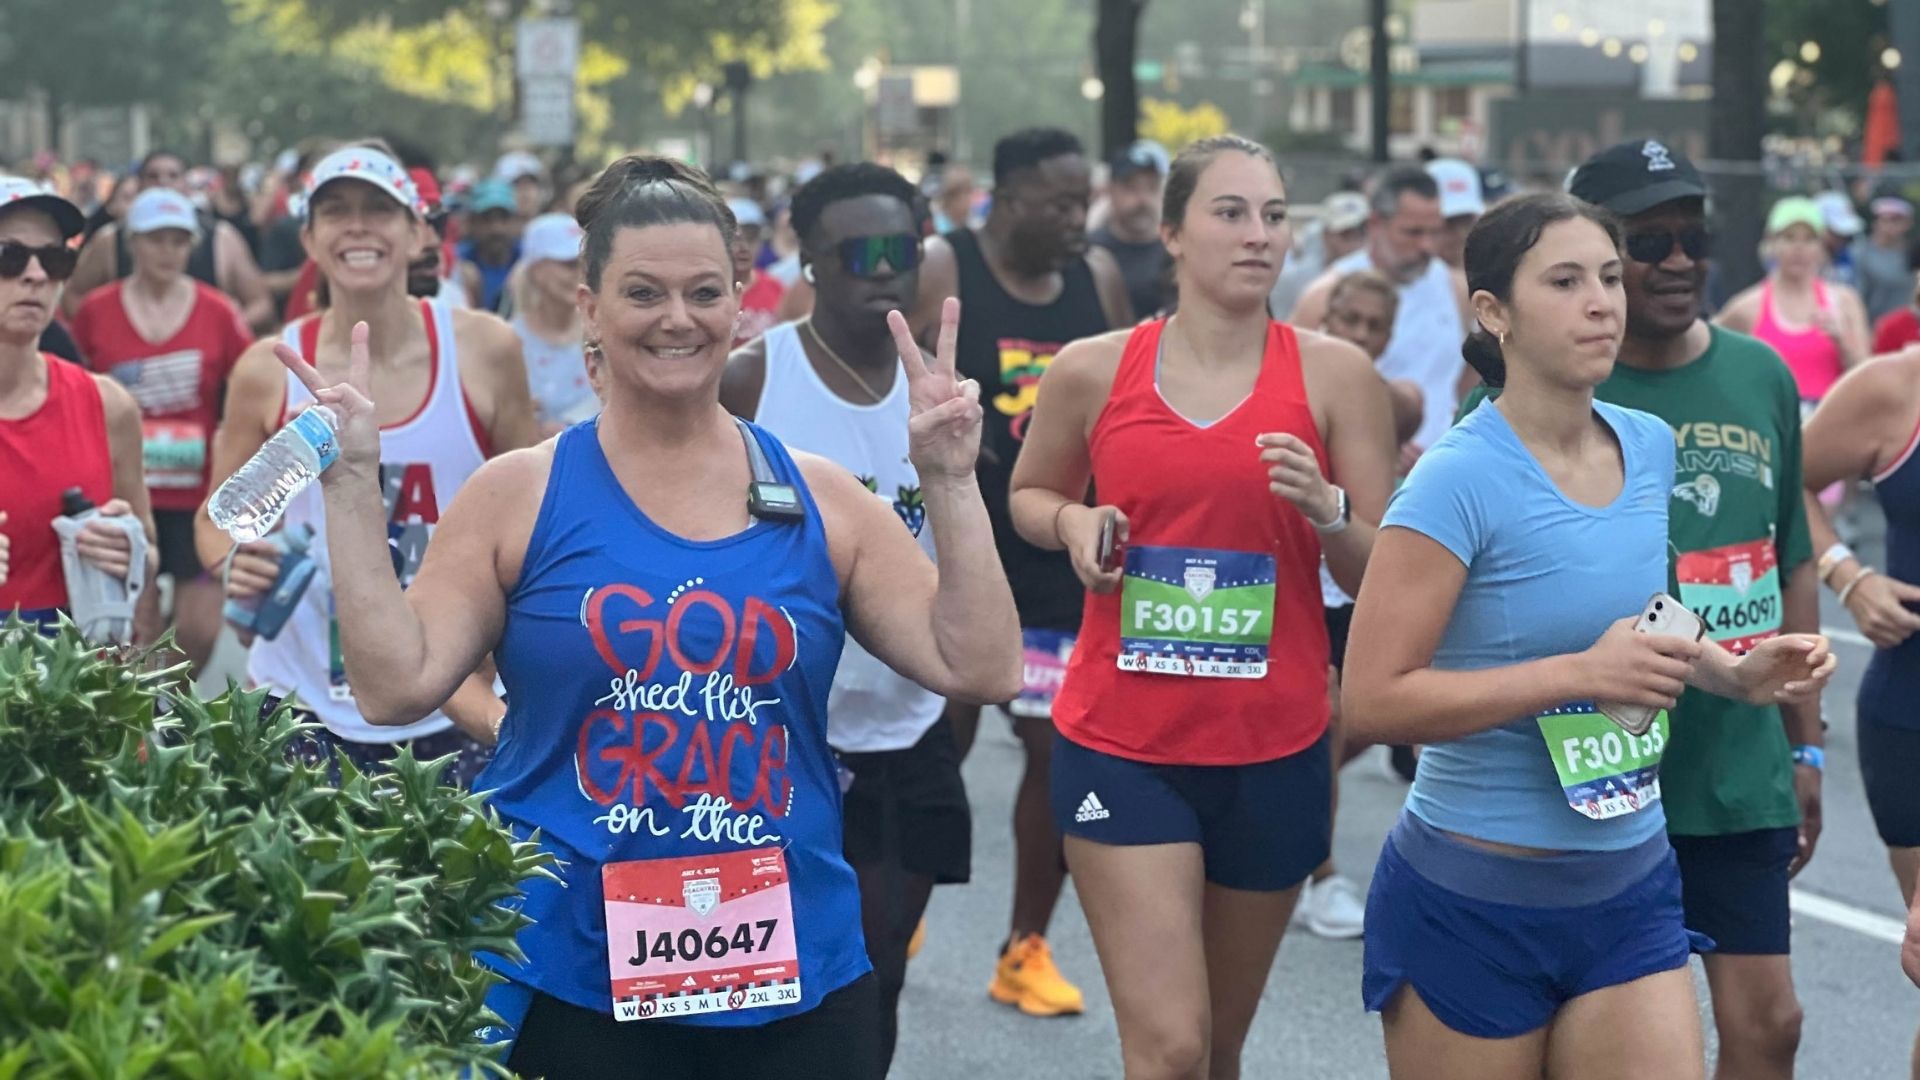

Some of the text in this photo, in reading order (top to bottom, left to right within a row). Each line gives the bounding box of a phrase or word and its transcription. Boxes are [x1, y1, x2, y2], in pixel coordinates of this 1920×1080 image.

[1675, 450, 1760, 480] MS
[1134, 600, 1262, 636] F30157
[1693, 594, 1776, 633] K46097
[587, 583, 795, 686] GOD
[1123, 658, 1134, 667] W
[1154, 660, 1166, 669] XS
[1172, 661, 1178, 671] S
[1199, 663, 1204, 672] L
[1210, 664, 1221, 674] XL
[1226, 665, 1241, 674] 2XL
[1248, 665, 1262, 674] 3XL
[594, 668, 781, 725] shed His
[593, 792, 781, 846] on thee
[1075, 809, 1110, 823] adidas
[628, 918, 779, 967] J40647
[622, 988, 798, 1017] W M XS S M L XL 2XL 3XL
